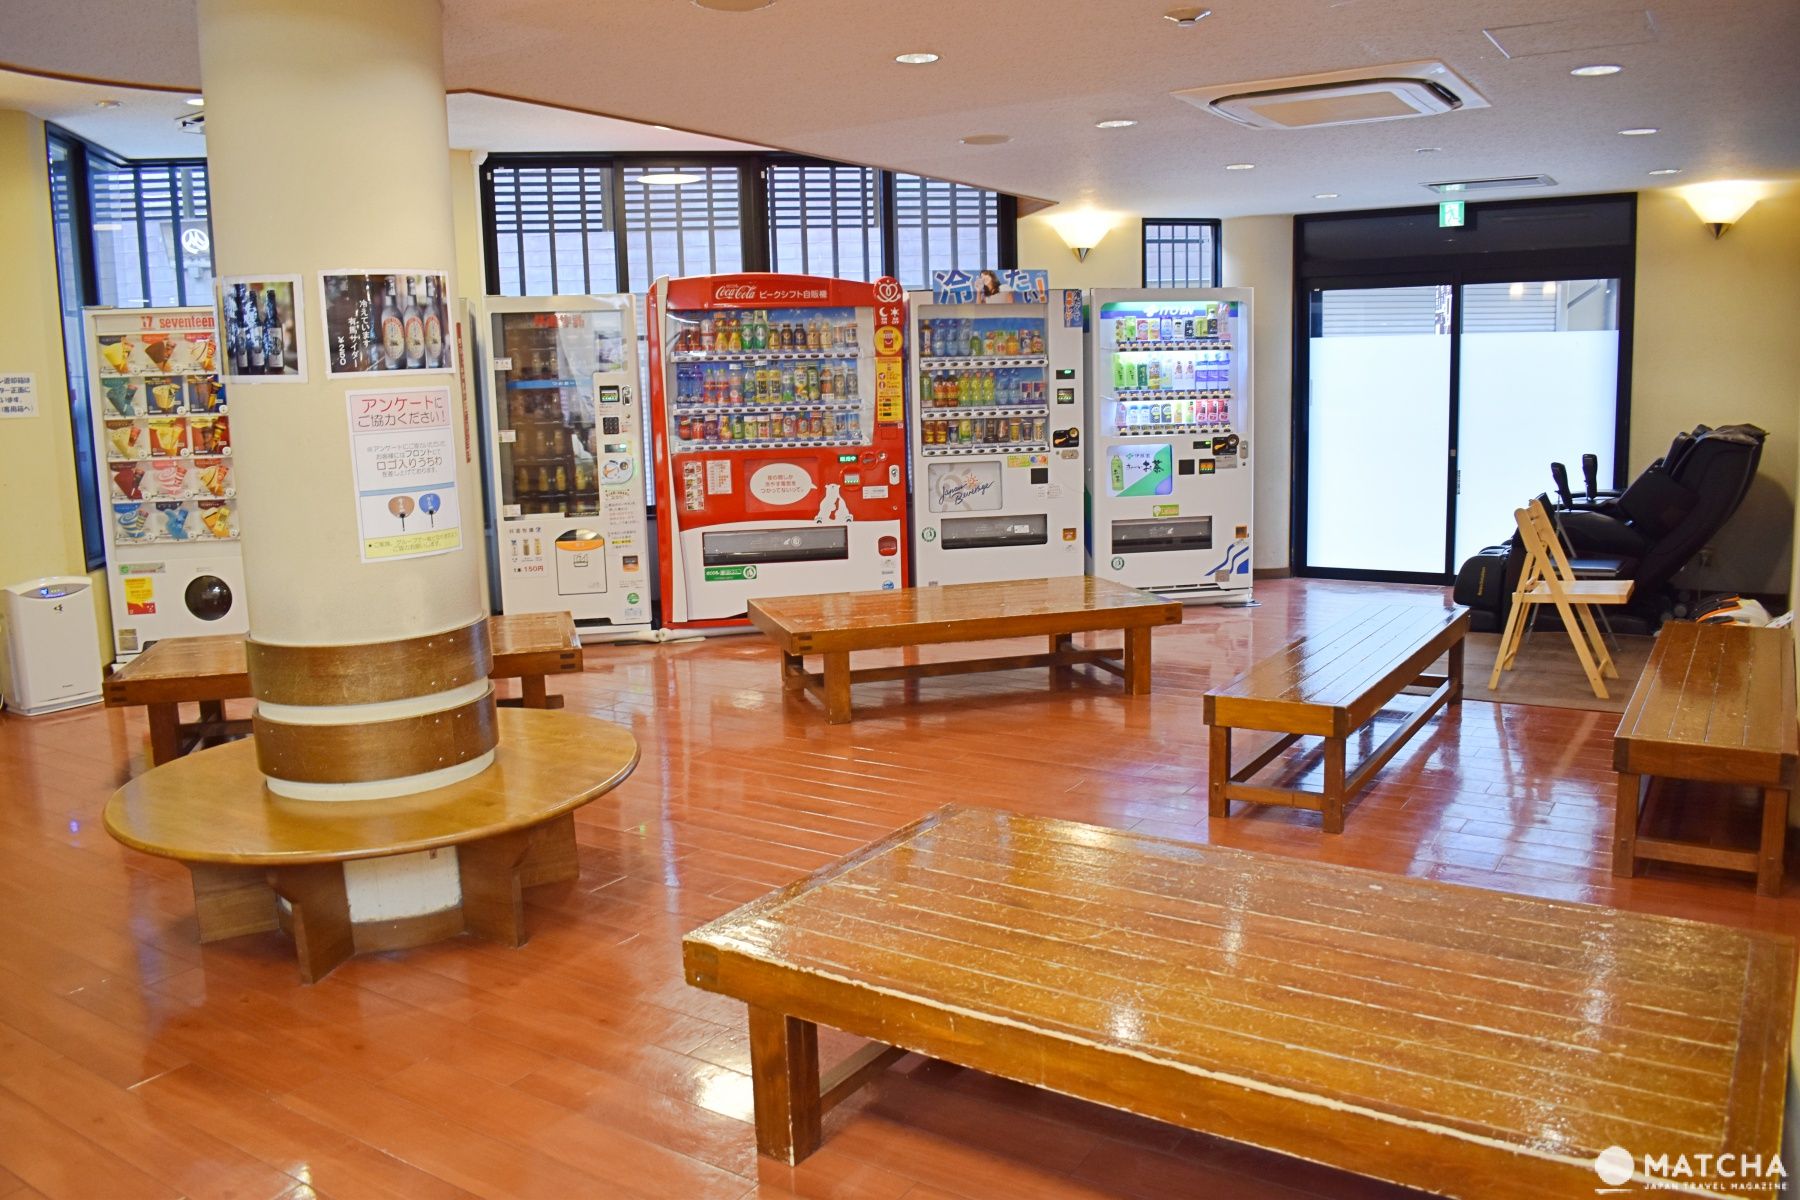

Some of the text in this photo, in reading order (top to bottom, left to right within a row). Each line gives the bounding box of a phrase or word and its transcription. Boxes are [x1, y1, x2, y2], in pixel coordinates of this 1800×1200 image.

[159, 315, 215, 329] seventeen
[361, 396, 443, 413] アンケートに
[358, 411, 446, 428] ご協力ください!
[376, 457, 442, 470] ロゴ入りうちわ
